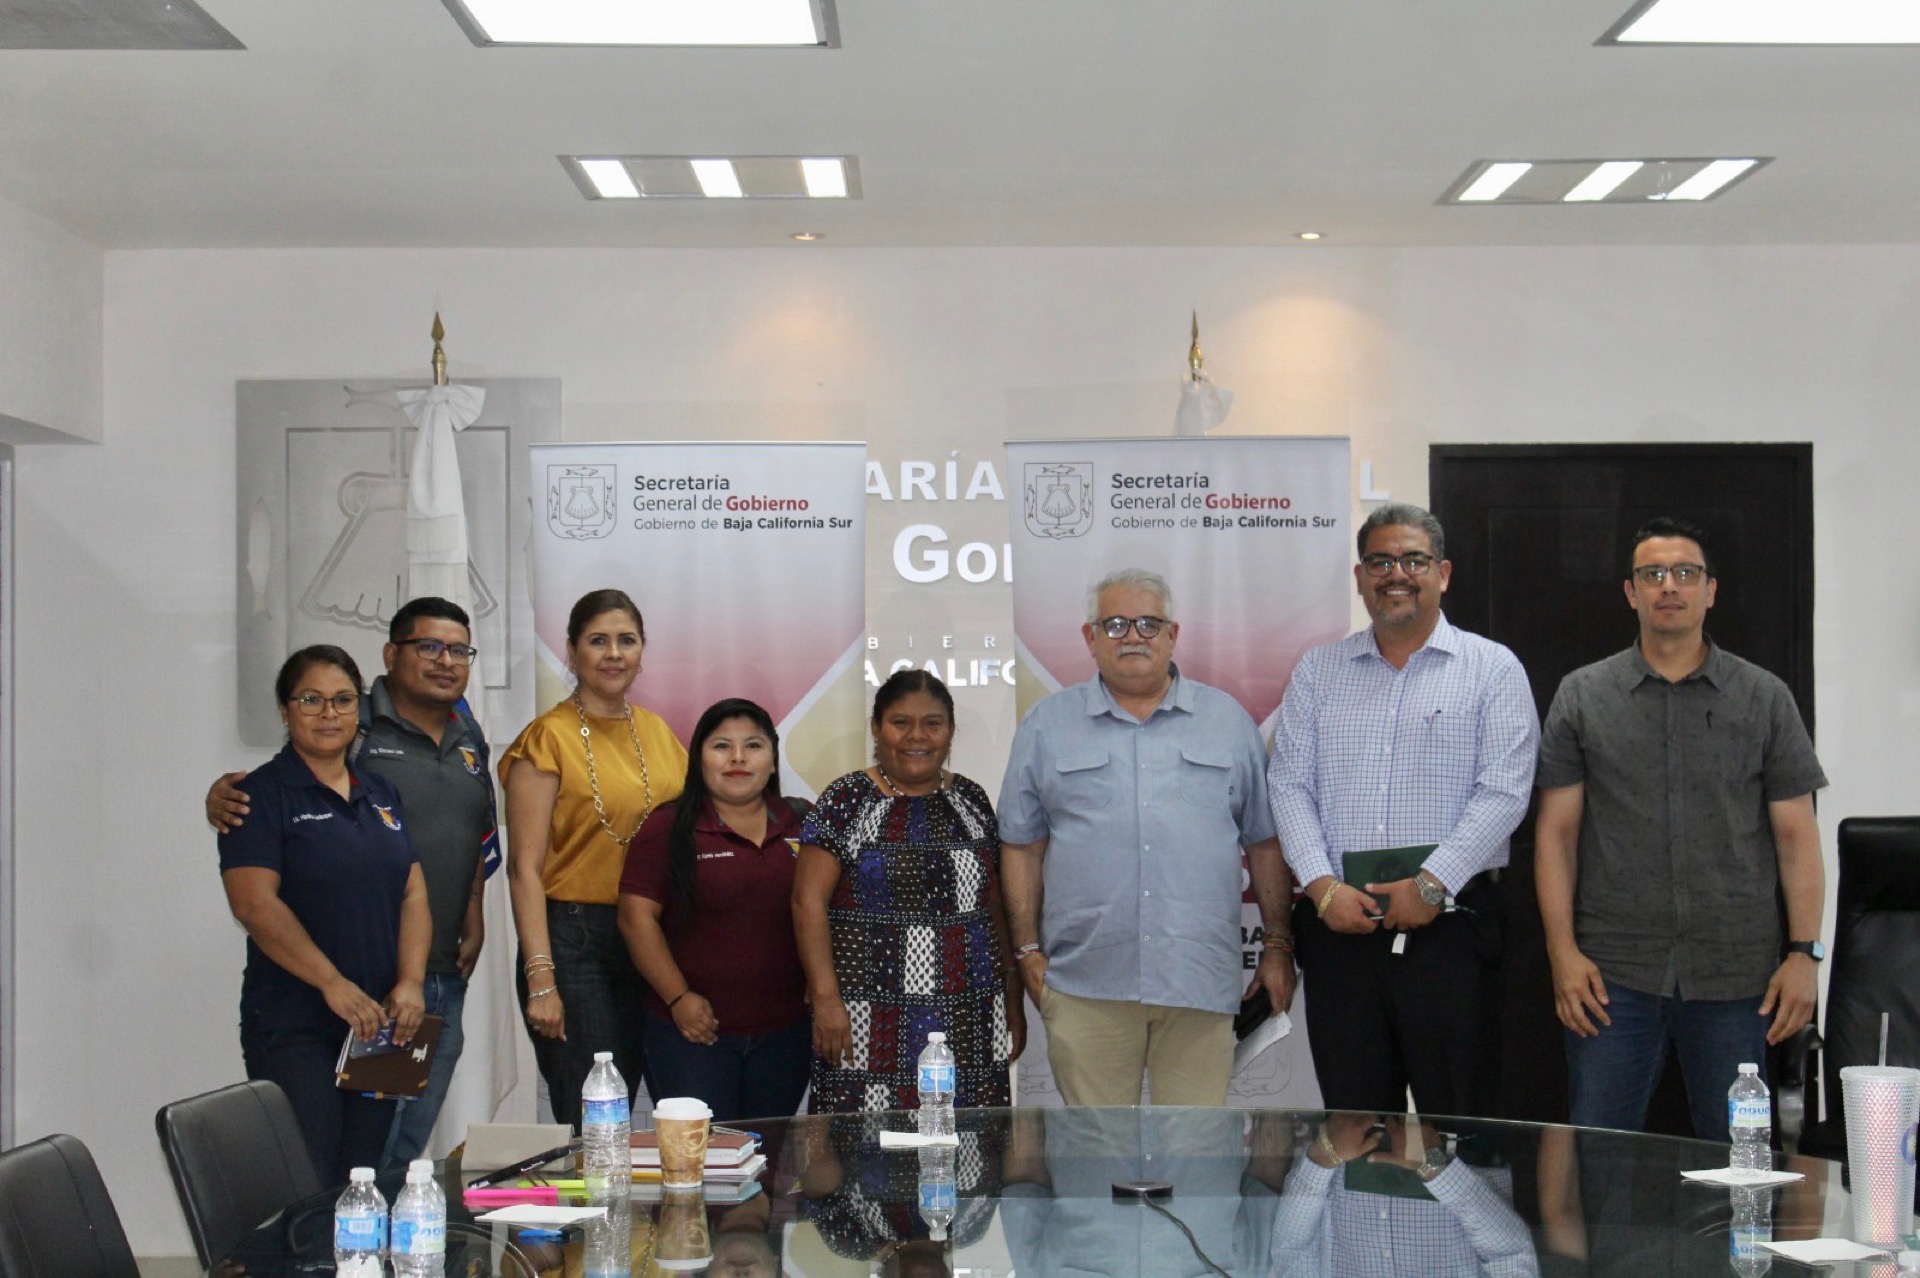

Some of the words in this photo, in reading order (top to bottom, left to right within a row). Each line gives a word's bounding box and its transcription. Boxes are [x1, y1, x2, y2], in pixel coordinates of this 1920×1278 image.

[633, 474, 731, 491] Secretaría
[1111, 472, 1210, 489] Secretaría
[633, 494, 698, 511] General
[701, 495, 723, 511] de
[726, 495, 810, 512] Gobierno
[1110, 492, 1176, 510] General
[1180, 493, 1202, 510] de
[1205, 493, 1291, 510] Gobierno
[633, 518, 696, 530] Gobierno
[700, 518, 719, 530] de
[723, 517, 753, 532] Baja
[757, 517, 825, 530] California
[829, 517, 853, 530] Sur
[1111, 516, 1175, 529] Gobierno
[1179, 516, 1198, 529] de
[1202, 515, 1233, 530] Baja
[1238, 515, 1308, 528] California
[1312, 515, 1337, 528] Sur
